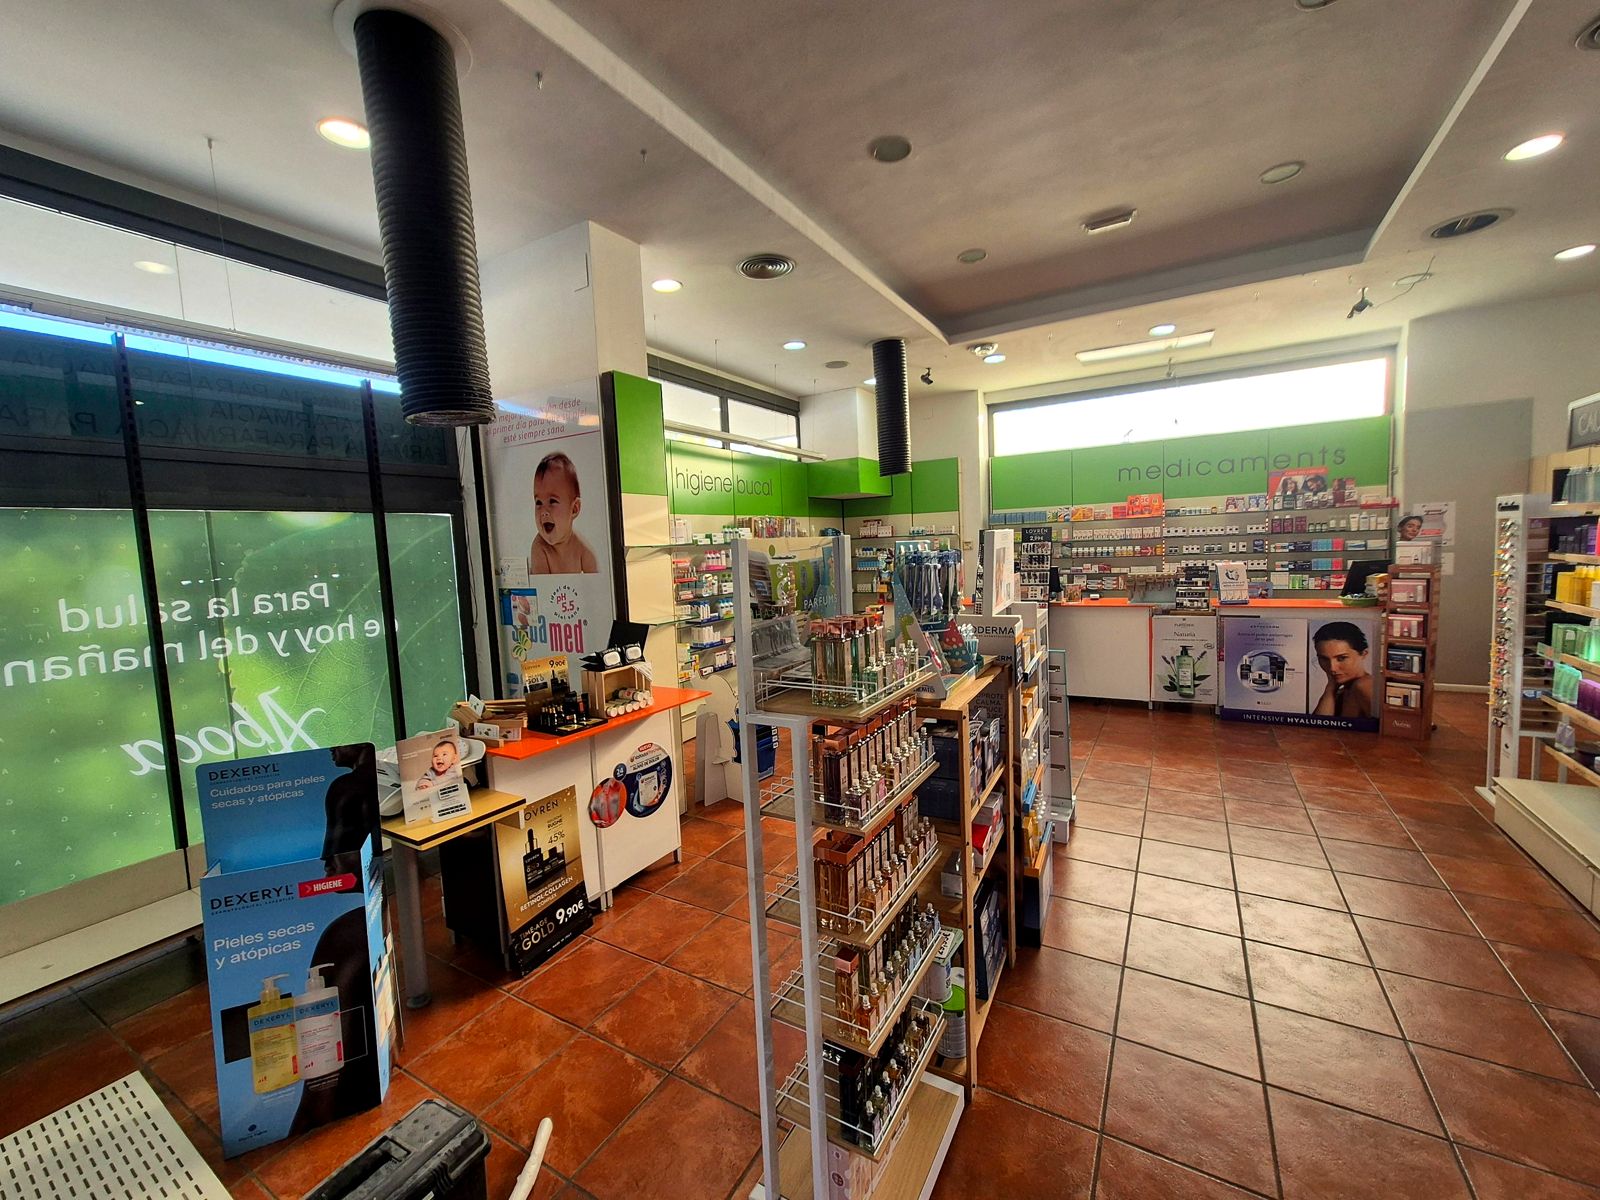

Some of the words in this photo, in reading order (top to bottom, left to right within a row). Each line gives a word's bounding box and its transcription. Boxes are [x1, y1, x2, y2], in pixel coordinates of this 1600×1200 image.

[1118, 445, 1347, 482] medicaments
[675, 467, 732, 496] higiene
[736, 475, 773, 497] bucal
[556, 592, 567, 605] pH
[561, 600, 575, 613] 5.5
[803, 594, 837, 610] PARFUMS
[1242, 713, 1285, 723] INTENSIVE
[1287, 716, 1353, 728] HYALURONIC+
[208, 763, 280, 781] DEXERYL
[210, 783, 265, 798] Cuidados
[267, 779, 292, 791] para
[294, 775, 326, 786] pieles
[211, 798, 246, 809] secas
[247, 796, 255, 806] y
[257, 788, 305, 803] atópicas
[547, 830, 566, 844] 45%
[313, 879, 343, 892] HIGIENE
[210, 887, 294, 910] DEXERYL
[555, 899, 585, 925] 9,90€
[213, 931, 265, 952] Pieles
[268, 922, 316, 940] secas
[522, 921, 555, 950] GOLD
[215, 956, 225, 970] y
[230, 939, 302, 965] atópicas
